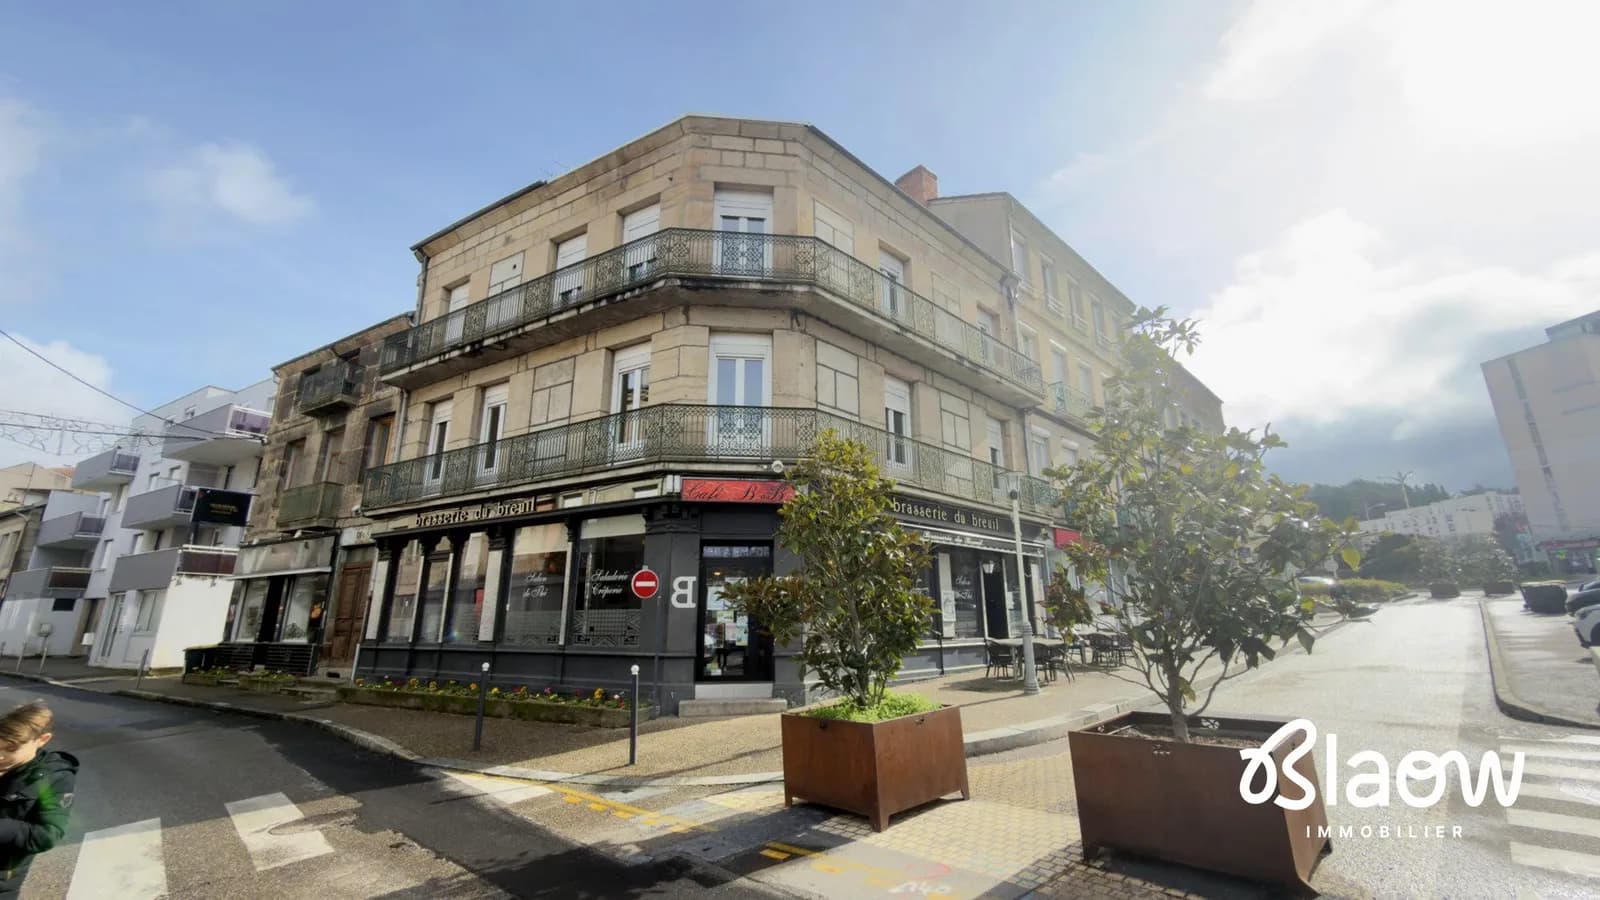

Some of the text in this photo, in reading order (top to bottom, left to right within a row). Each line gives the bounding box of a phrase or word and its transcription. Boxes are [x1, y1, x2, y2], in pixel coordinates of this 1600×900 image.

[415, 496, 536, 527] brasserie du breuil
[893, 497, 999, 530] brasserie du breuil
